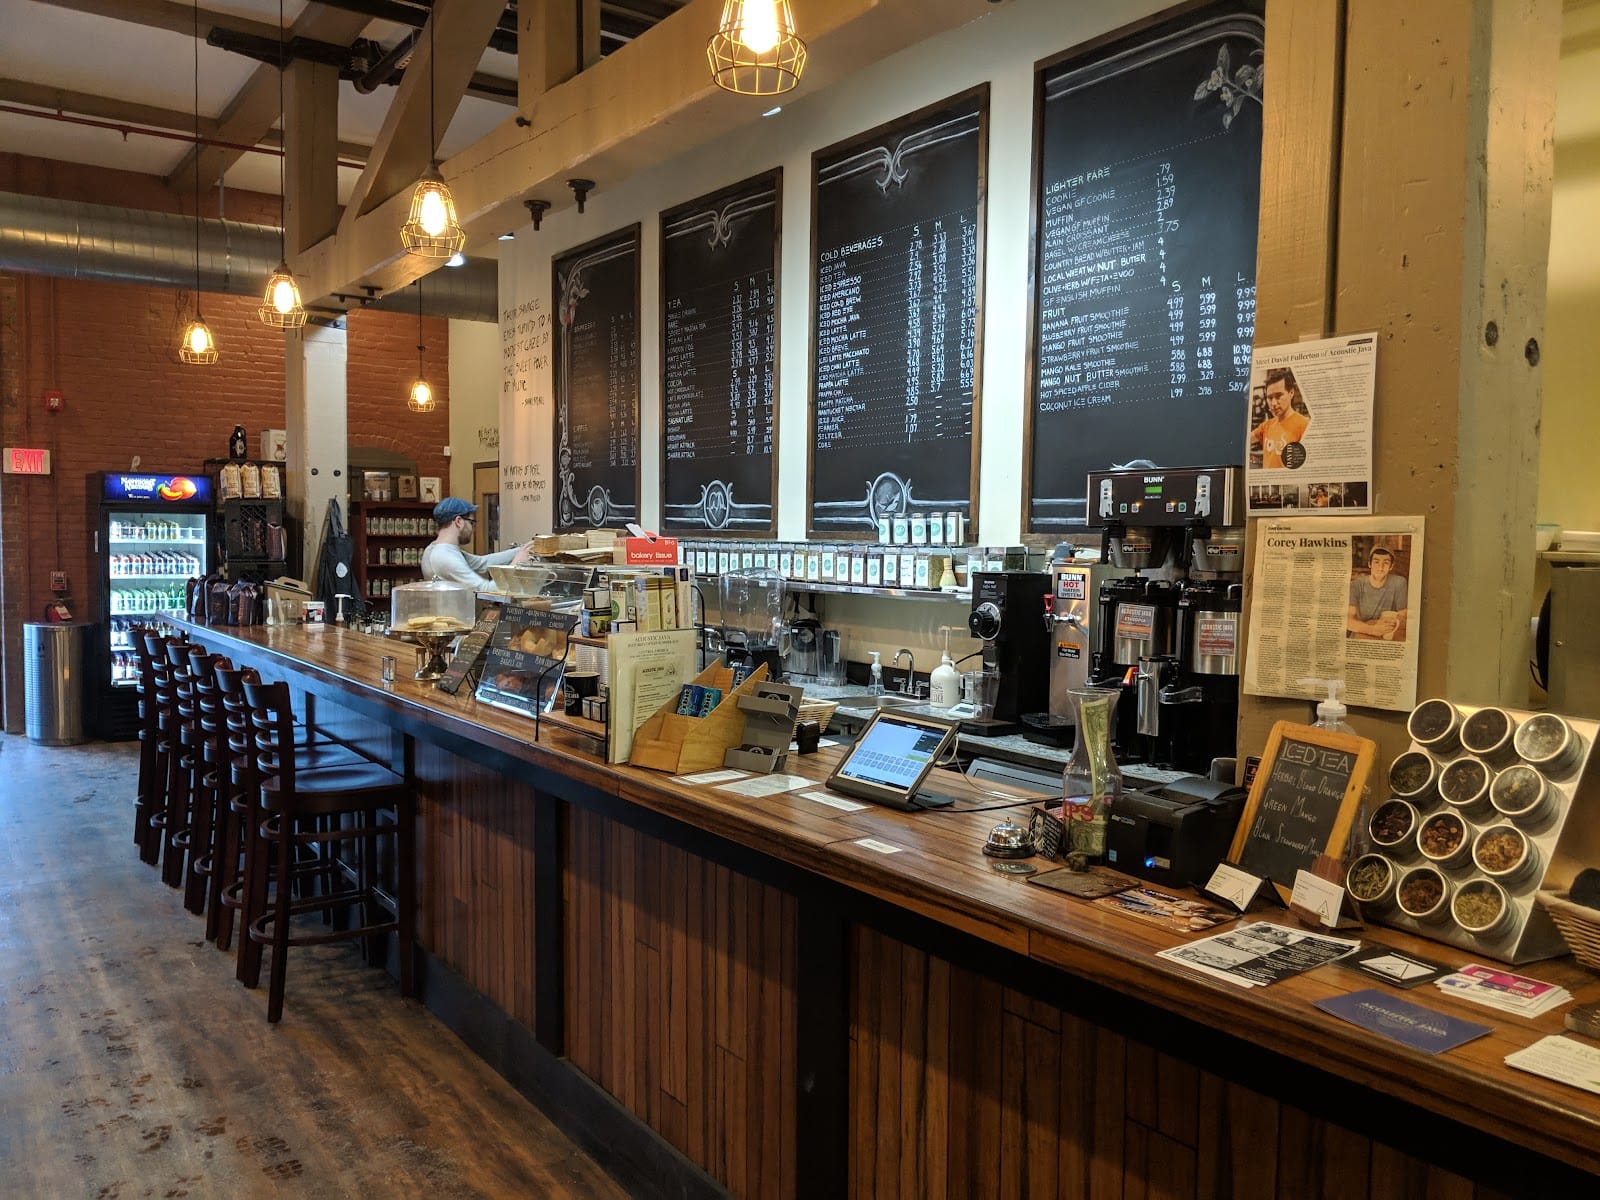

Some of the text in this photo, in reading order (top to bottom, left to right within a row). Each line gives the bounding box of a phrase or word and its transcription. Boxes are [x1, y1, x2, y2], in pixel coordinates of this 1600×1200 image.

[1046, 167, 1111, 195] LIGHTER FARE
[1045, 185, 1176, 228] MUFFIN 2.39
[1046, 202, 1073, 217] VEGAN
[1086, 190, 1115, 205] COOKIE
[1156, 173, 1174, 187] 1.59
[1046, 188, 1077, 206] COOKIE
[820, 215, 968, 263] COLD BEVERAGES S M L
[1045, 225, 1071, 240] VEGAN
[1082, 214, 1110, 228] MUFFIN
[1045, 211, 1164, 249] PLAIN CROISSANT 2
[1044, 230, 1130, 261] BAGEL CHEESE
[1044, 236, 1164, 272] COUNTRY BREAD 4
[1043, 271, 1065, 285] LOCAL
[1097, 259, 1117, 272] NUT
[1120, 253, 1146, 267] BUTTER
[1159, 248, 1166, 260] 4
[1159, 261, 1166, 273] 4
[1042, 271, 1246, 321] FRUIT S M L
[1055, 290, 1088, 304] ENGLISH
[1089, 284, 1121, 298] MUFFIN
[1159, 275, 1166, 287] 4
[667, 298, 682, 310] TEA
[1042, 318, 1069, 332] BANANA
[1070, 314, 1089, 326] FRUIT
[1089, 306, 1130, 321] SMOOTHIE
[1042, 328, 1076, 343] BLUEBERRY
[1077, 324, 1093, 335] FRUIT
[1093, 319, 1127, 333] SMOOTHIE
[1237, 299, 1256, 311] 9.99
[849, 330, 867, 341] LATTE
[1041, 341, 1066, 354] MANGO
[1067, 337, 1086, 348] FRUIT
[1087, 330, 1123, 344] SMOOTHIE
[1041, 351, 1085, 365] STRAWBERRY
[1085, 346, 1105, 357] FRUIT
[1106, 341, 1139, 353] SMOOTHIE
[1236, 326, 1255, 339] 9.99
[842, 359, 861, 369] LATTE
[1040, 366, 1064, 378] MANGO
[1064, 363, 1082, 373] KALE
[1082, 357, 1116, 370] SMOOTHIE
[1255, 345, 1372, 366] Meet David Fullerton of Acoustic Java
[1040, 377, 1061, 389] MANGO
[1063, 373, 1082, 385] NUT
[1086, 369, 1114, 382] BUTTER
[1114, 364, 1150, 377] SMOOTHIE
[1040, 389, 1053, 400] HOT
[1053, 386, 1077, 396] SPICED
[1077, 382, 1097, 393] APPLE
[1098, 379, 1120, 389] CIDER
[1039, 394, 1111, 411] COCONUT ICE CREAM
[11, 449, 44, 473] EXIT
[1143, 476, 1164, 484] BUNN
[630, 551, 654, 560] bakery
[1267, 536, 1349, 550] Corey Hawkins
[1060, 573, 1083, 581] BUNN
[1281, 742, 1351, 774] ICED TEA
[1263, 787, 1318, 823] GREEN MANGO
[1357, 1001, 1449, 1037] ACOUSTIC JAVA
